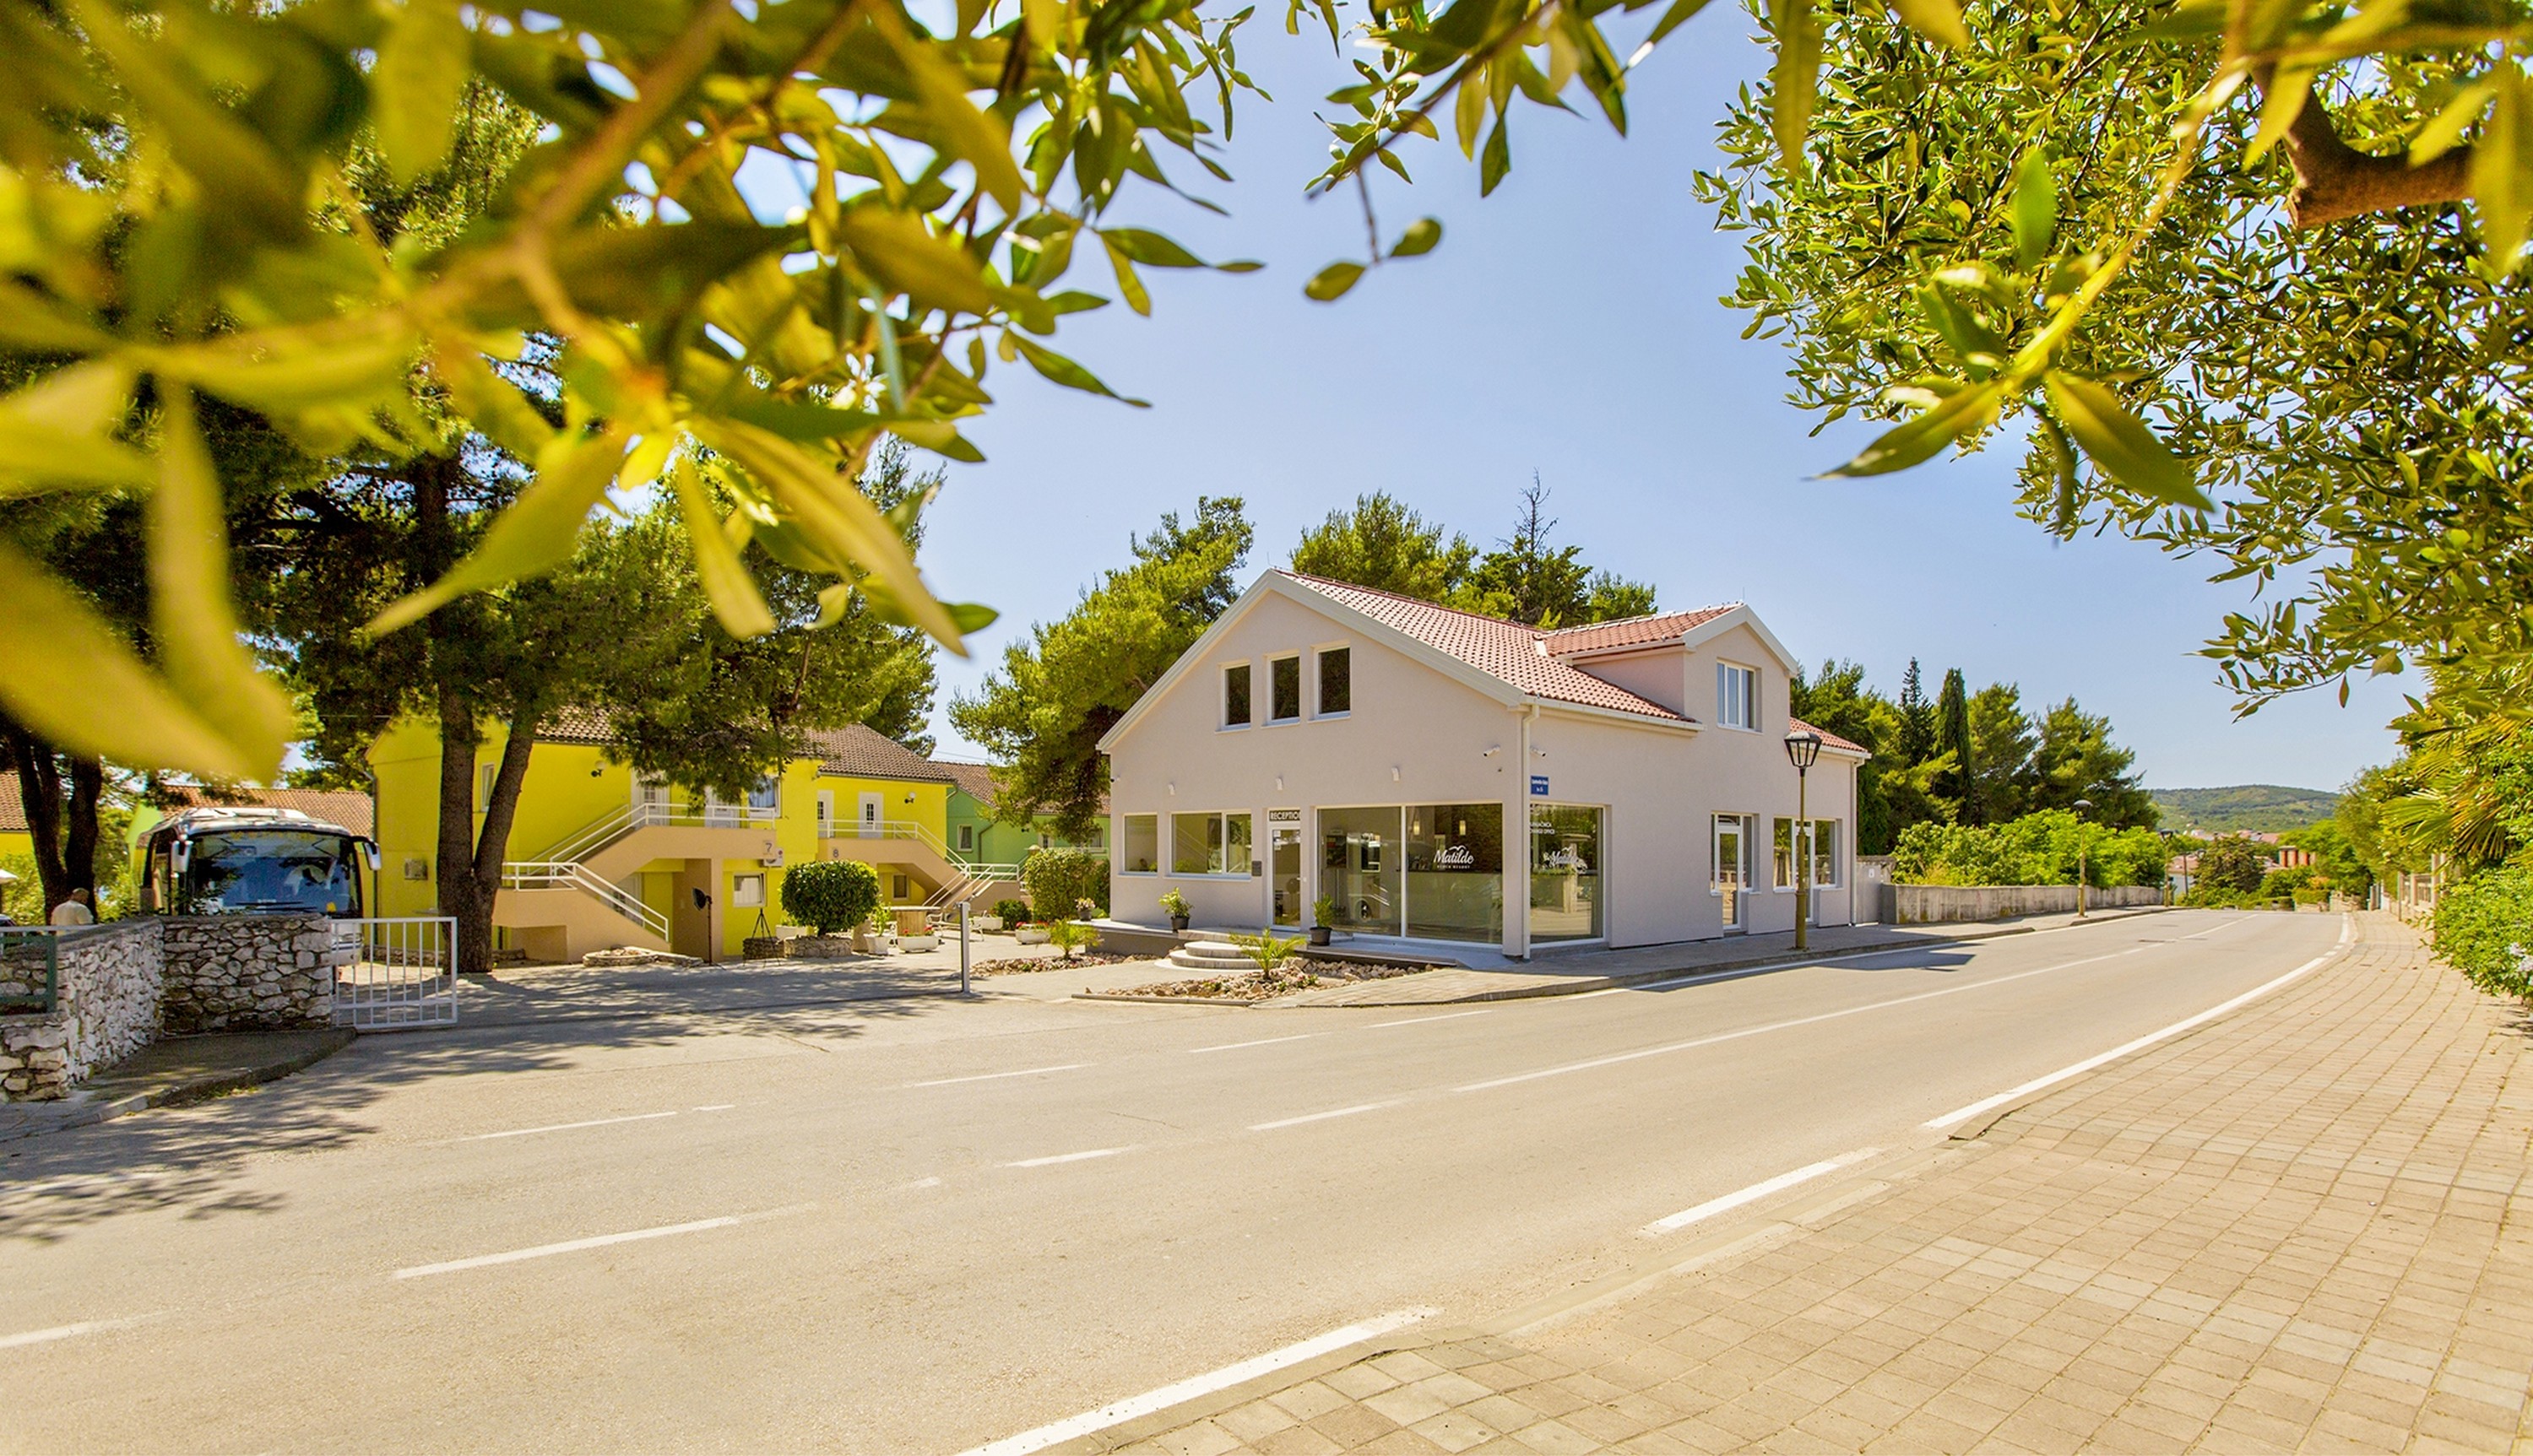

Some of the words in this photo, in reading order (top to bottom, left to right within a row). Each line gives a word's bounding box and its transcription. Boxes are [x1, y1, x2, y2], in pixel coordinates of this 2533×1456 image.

[766, 842, 773, 852] 7
[833, 848, 839, 858] 8
[1434, 849, 1474, 864] Matilde
